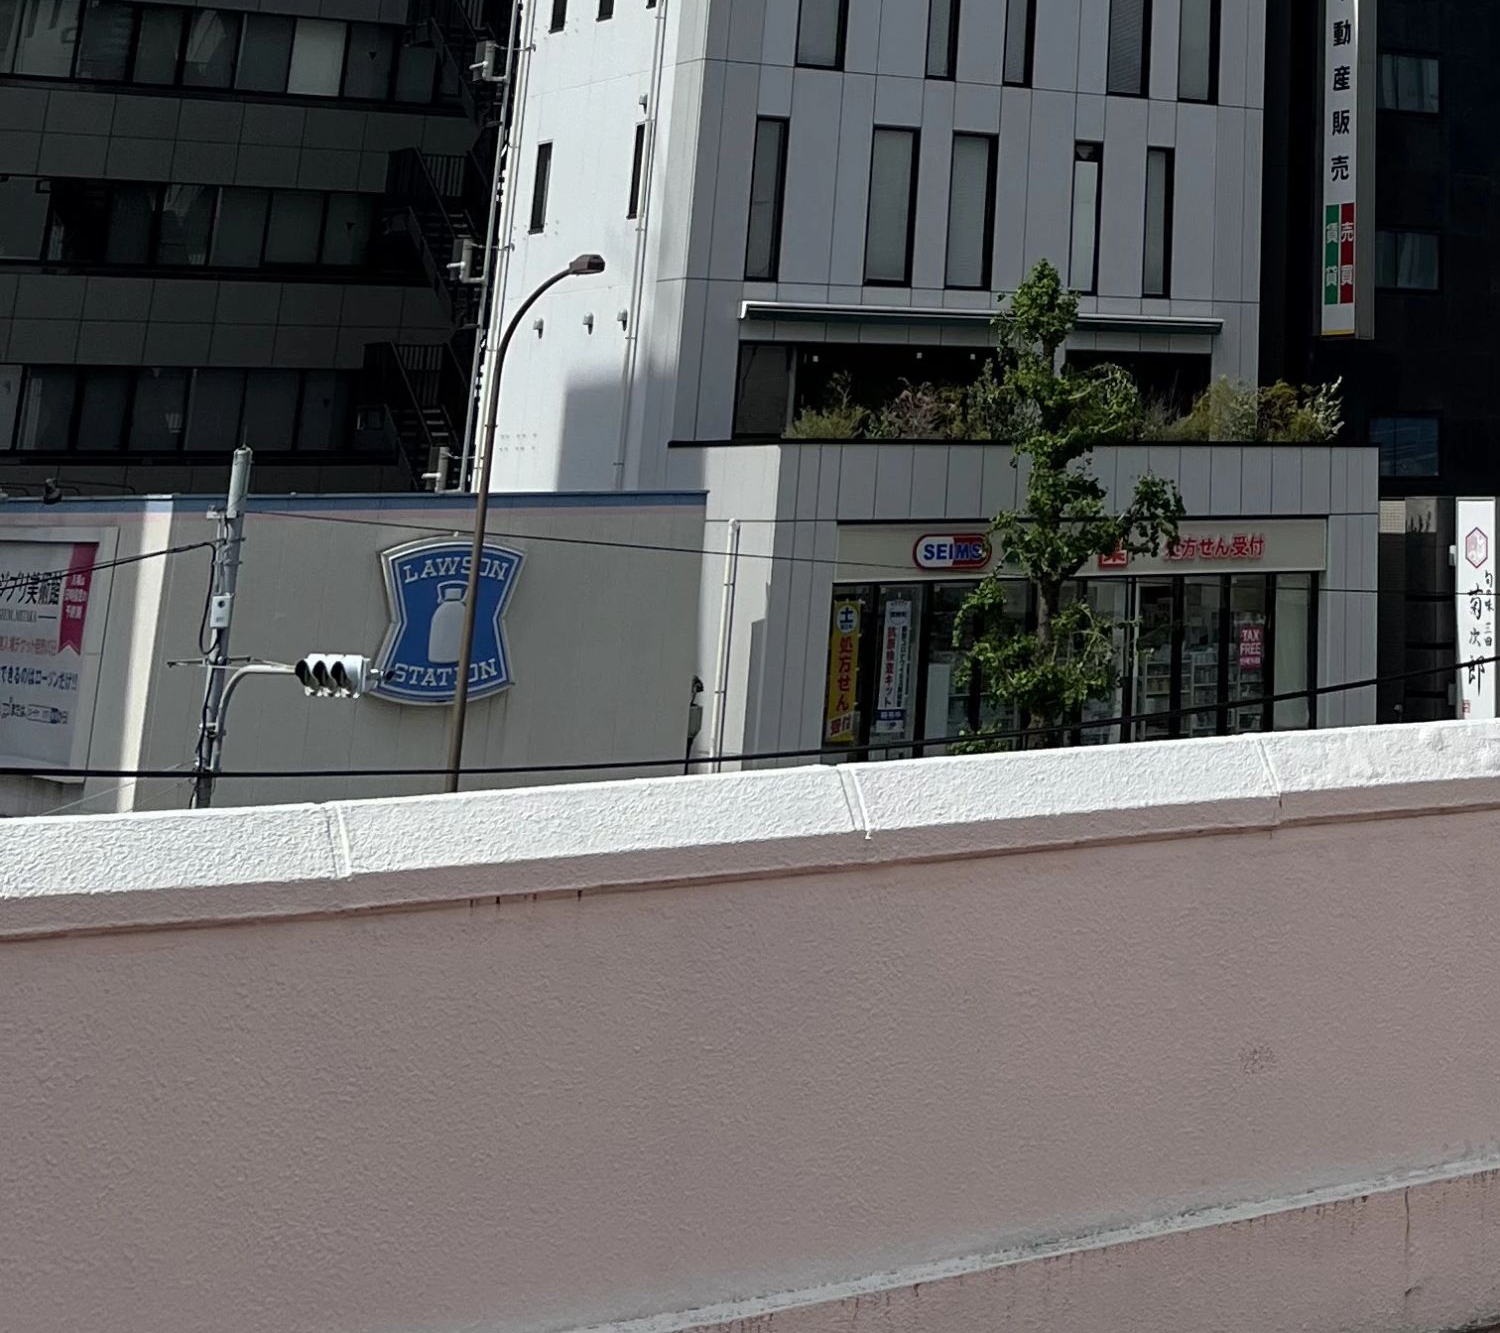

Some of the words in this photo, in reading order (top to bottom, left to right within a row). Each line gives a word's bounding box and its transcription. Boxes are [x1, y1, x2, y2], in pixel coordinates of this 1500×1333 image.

[923, 541, 983, 561] SEIMS
[402, 556, 510, 584] LAWSON
[1239, 642, 1262, 656] FREE
[1241, 629, 1260, 642] TAX
[1467, 582, 1486, 697] 菊次郎
[394, 658, 497, 687] STATON
[836, 635, 854, 712] 処方せん
